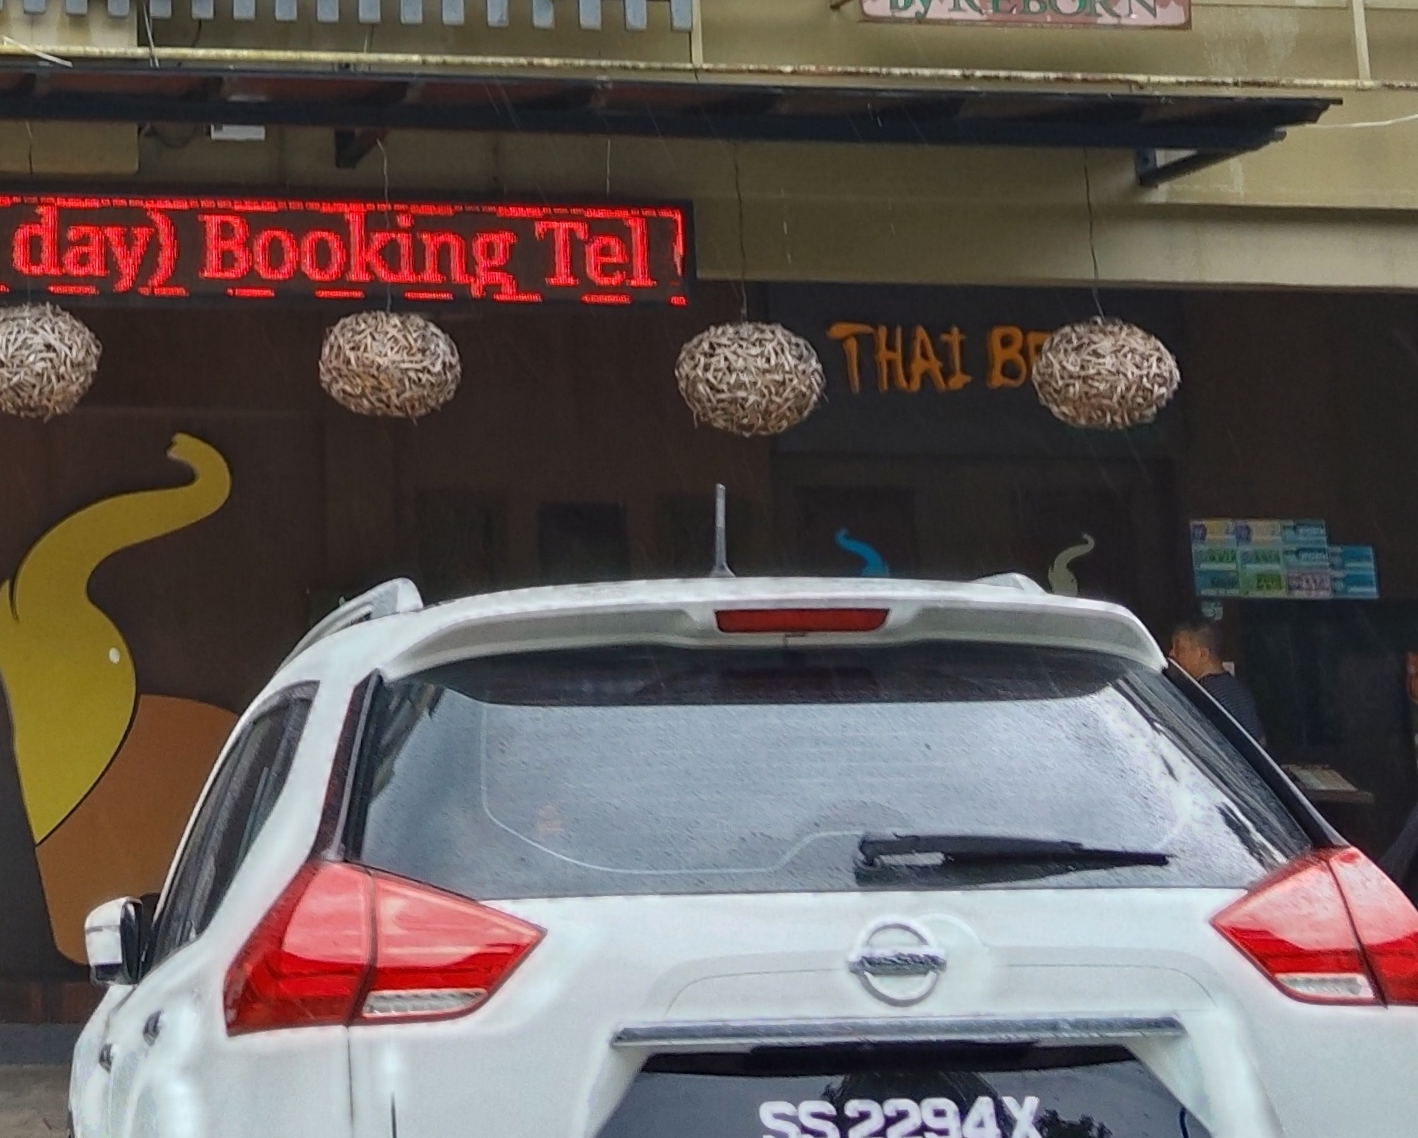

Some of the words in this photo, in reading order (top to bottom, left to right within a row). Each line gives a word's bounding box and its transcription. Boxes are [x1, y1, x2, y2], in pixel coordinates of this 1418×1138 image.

[11, 203, 181, 293] day)
[198, 207, 520, 299] Booking
[533, 216, 659, 288] Tel
[826, 321, 973, 394] THAI
